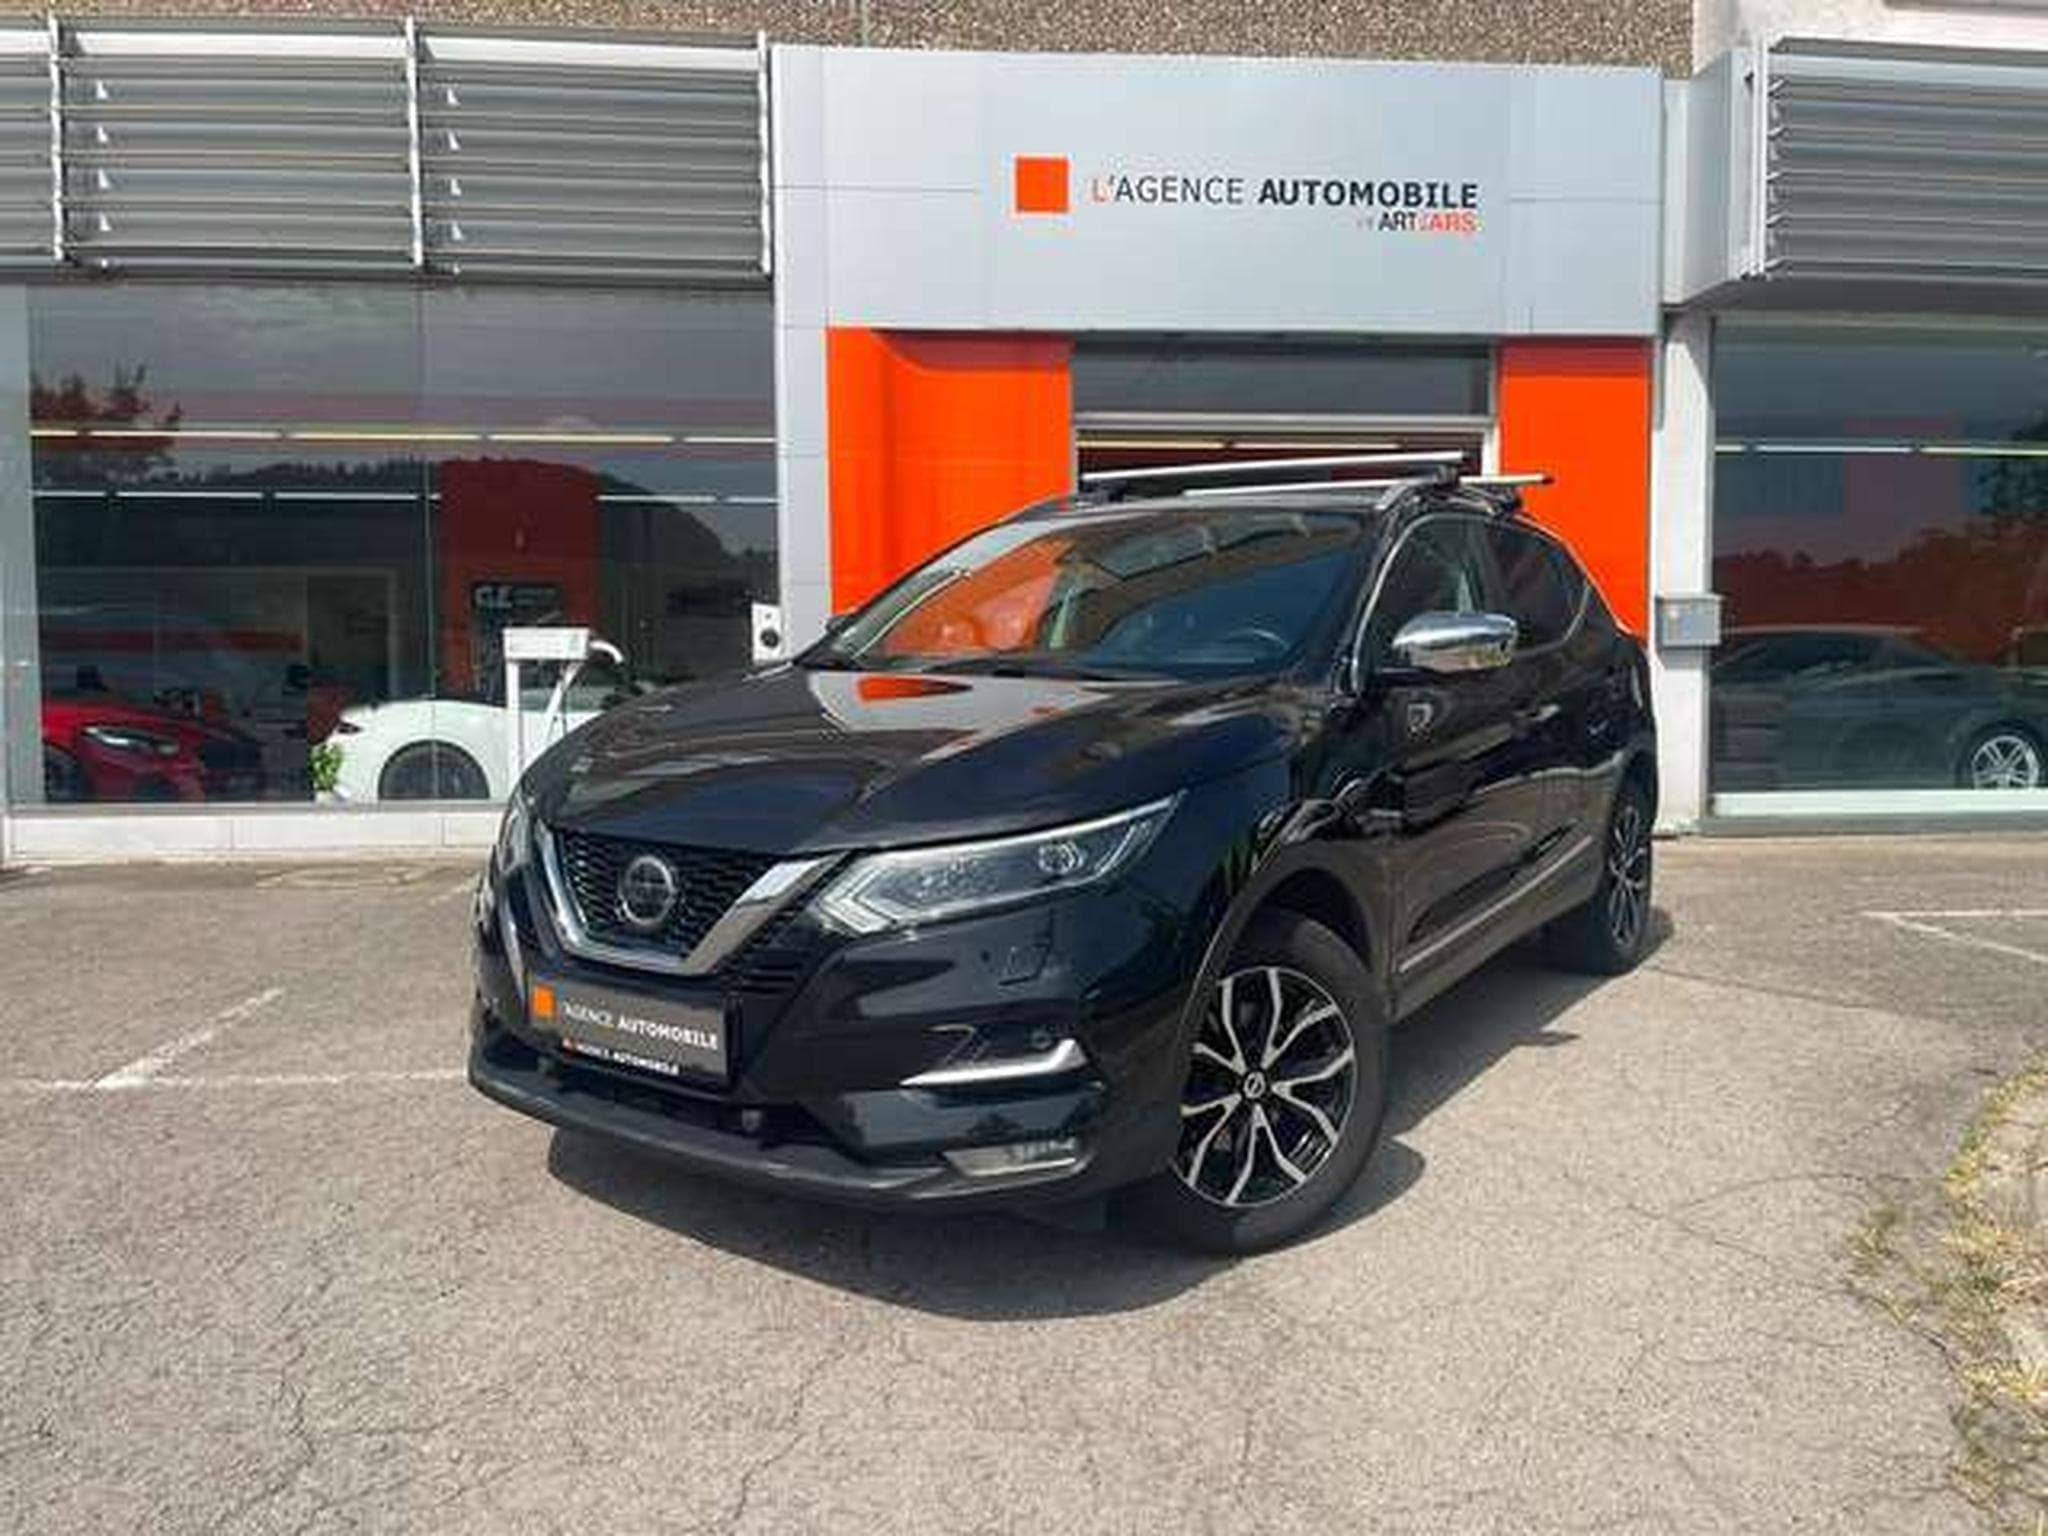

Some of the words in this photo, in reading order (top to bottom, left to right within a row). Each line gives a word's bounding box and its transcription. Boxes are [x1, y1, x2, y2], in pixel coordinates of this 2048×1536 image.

[1092, 175, 1244, 204] L'AGENCE
[1258, 178, 1477, 208] AUTOMOBILE
[617, 1015, 719, 1050] AUTOMOBILE
